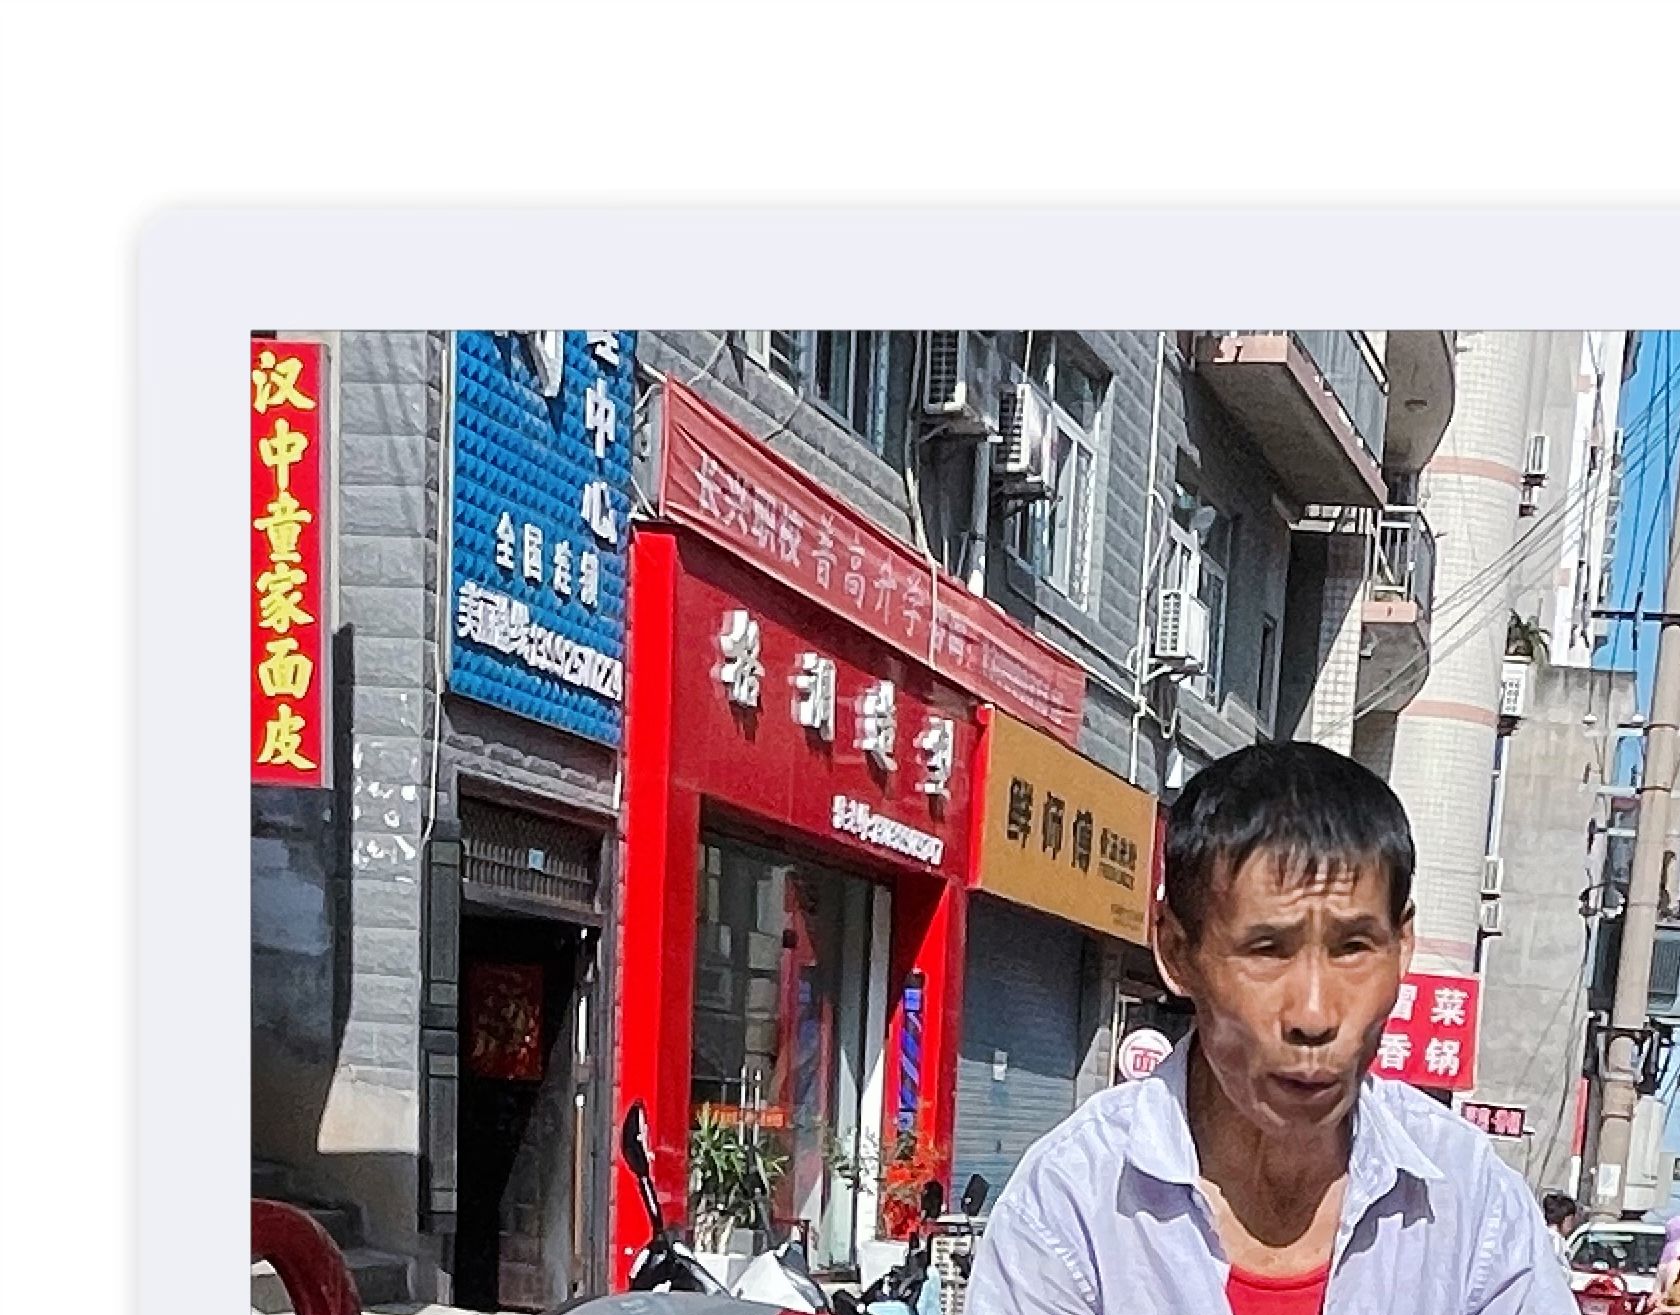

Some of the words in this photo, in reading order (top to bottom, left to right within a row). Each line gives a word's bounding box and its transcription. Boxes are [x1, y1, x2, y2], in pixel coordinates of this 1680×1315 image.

[252, 350, 317, 770] 汉中童家面皮
[1376, 1033, 1463, 1077] 香锅
